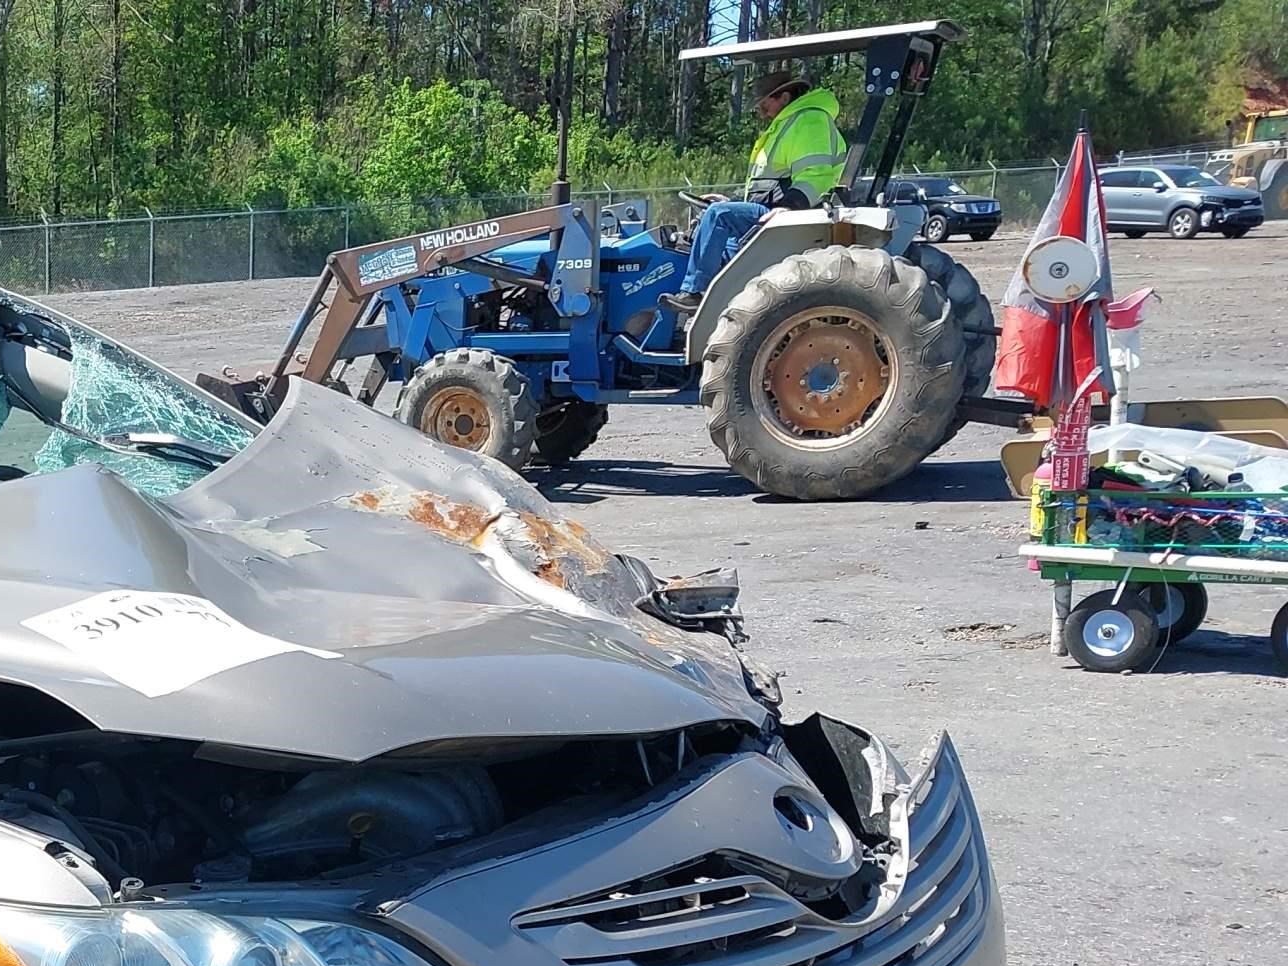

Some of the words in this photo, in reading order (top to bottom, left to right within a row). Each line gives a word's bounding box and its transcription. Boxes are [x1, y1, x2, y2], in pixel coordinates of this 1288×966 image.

[420, 234, 445, 250] NEW
[446, 222, 500, 244] HOLLAND
[557, 259, 593, 270] 7309
